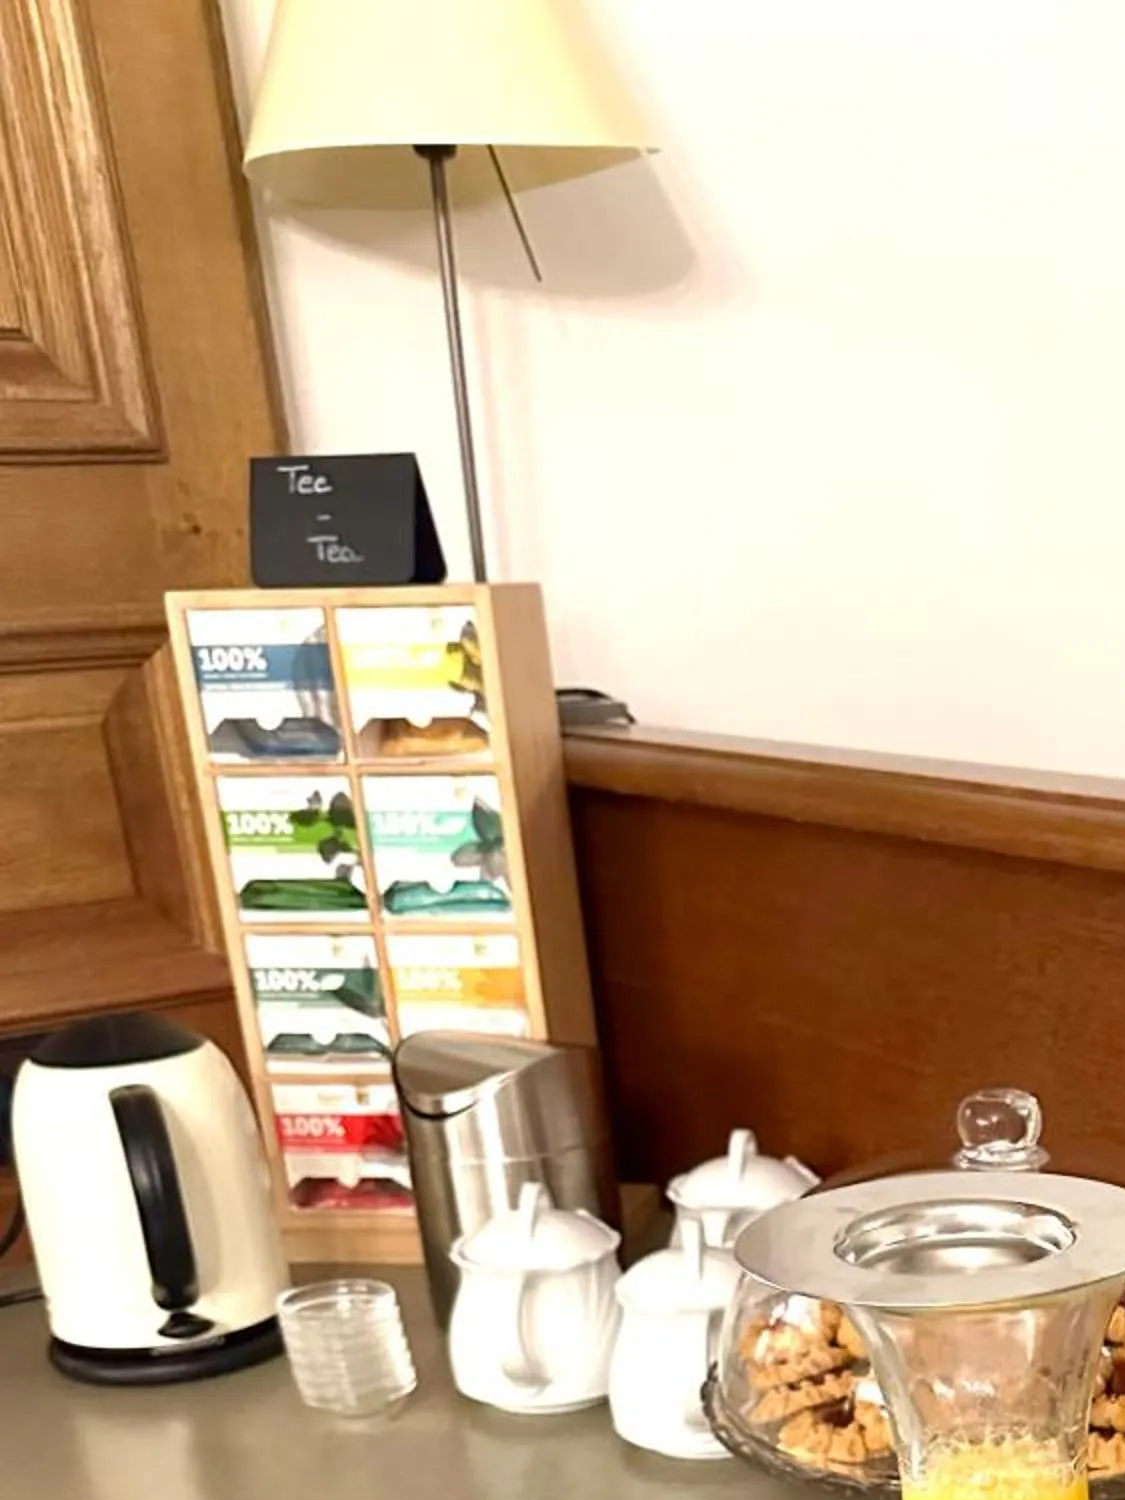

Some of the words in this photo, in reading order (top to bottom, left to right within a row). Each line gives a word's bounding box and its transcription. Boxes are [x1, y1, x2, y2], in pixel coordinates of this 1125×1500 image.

[277, 465, 332, 494] Tee
[307, 535, 364, 563] Tea
[198, 646, 268, 671] 100%
[226, 812, 295, 836] 100%
[254, 969, 321, 990] 100%
[281, 1117, 346, 1137] 100%
